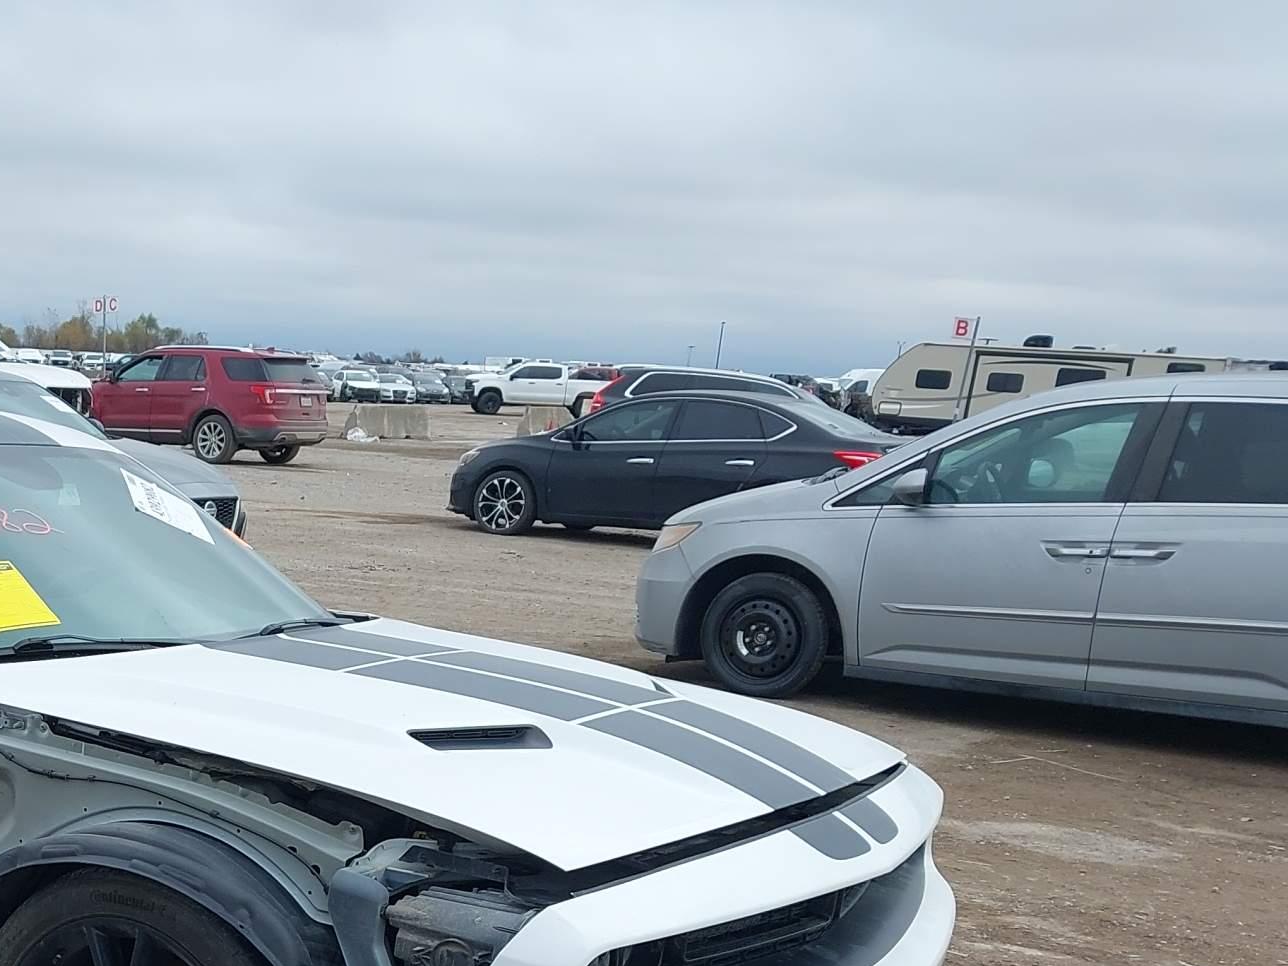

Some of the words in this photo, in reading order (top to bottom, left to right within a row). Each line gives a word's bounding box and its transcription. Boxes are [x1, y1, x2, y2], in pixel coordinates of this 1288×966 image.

[95, 299, 103, 313] D
[109, 298, 117, 311] C
[955, 319, 969, 336] B
